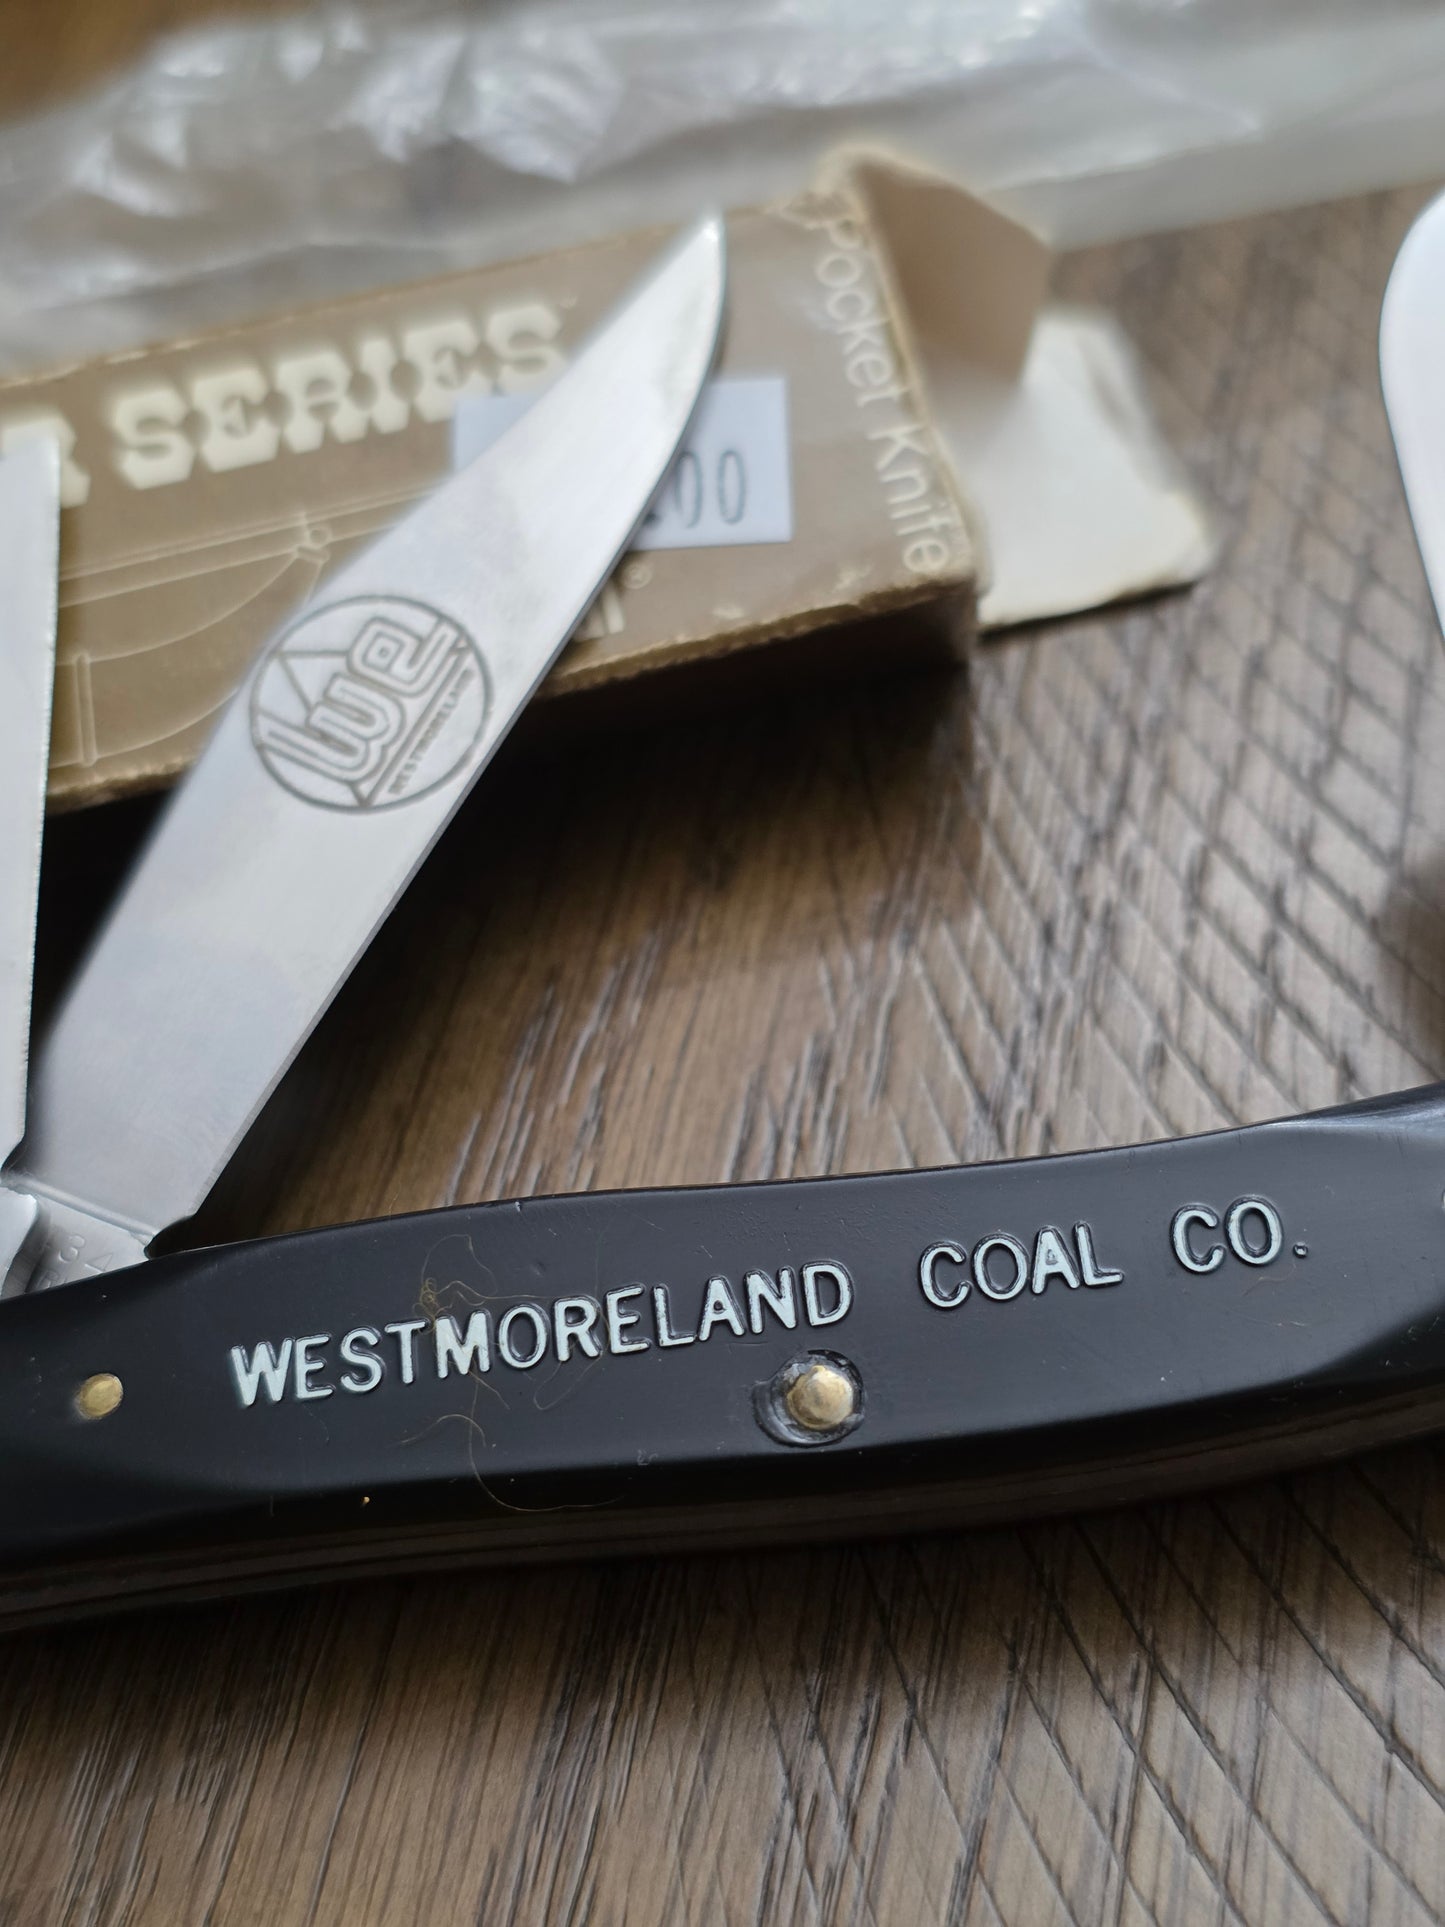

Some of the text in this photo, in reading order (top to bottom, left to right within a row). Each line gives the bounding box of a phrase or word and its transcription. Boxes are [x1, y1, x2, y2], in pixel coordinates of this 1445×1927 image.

[113, 303, 563, 488] SERIES
[807, 216, 951, 573] Pocket Knife
[229, 1195, 1310, 1407] WESTMORELAND COAL CO.
